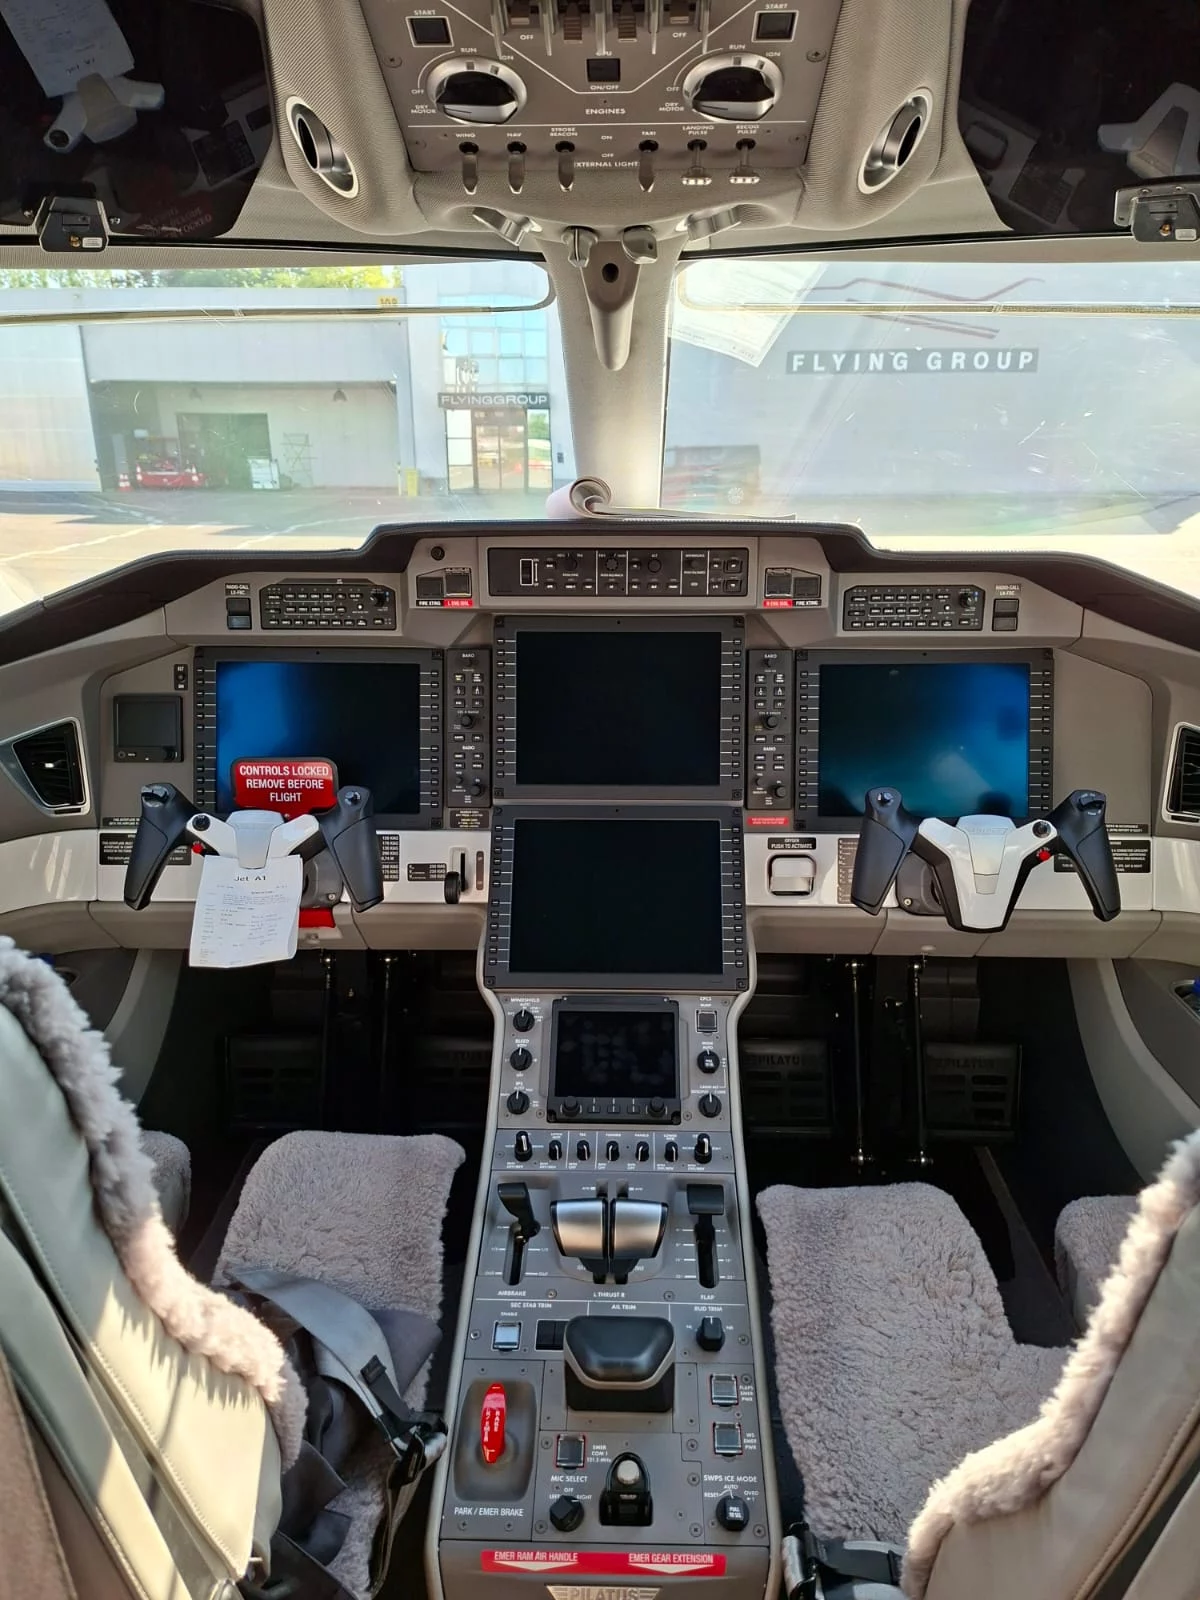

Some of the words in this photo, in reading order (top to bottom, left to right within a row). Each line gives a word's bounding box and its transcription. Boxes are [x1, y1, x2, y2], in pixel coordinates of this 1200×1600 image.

[792, 352, 908, 372] FLYING
[926, 351, 1033, 370] GROUP
[240, 766, 290, 776] CONTROLS
[292, 766, 329, 776] LOCKED
[246, 779, 285, 789] REMOVE
[288, 779, 324, 789] BEFORE
[270, 792, 302, 802] FLIGHT
[494, 1551, 514, 1560] EMER
[517, 1552, 533, 1560] RAM
[535, 1552, 546, 1561] AIR
[549, 1552, 578, 1562] HANDLE
[628, 1553, 650, 1562] EMER
[652, 1554, 671, 1563] GEAR
[673, 1554, 713, 1564] EXTENSION
[568, 1587, 639, 1600] PILATUS
